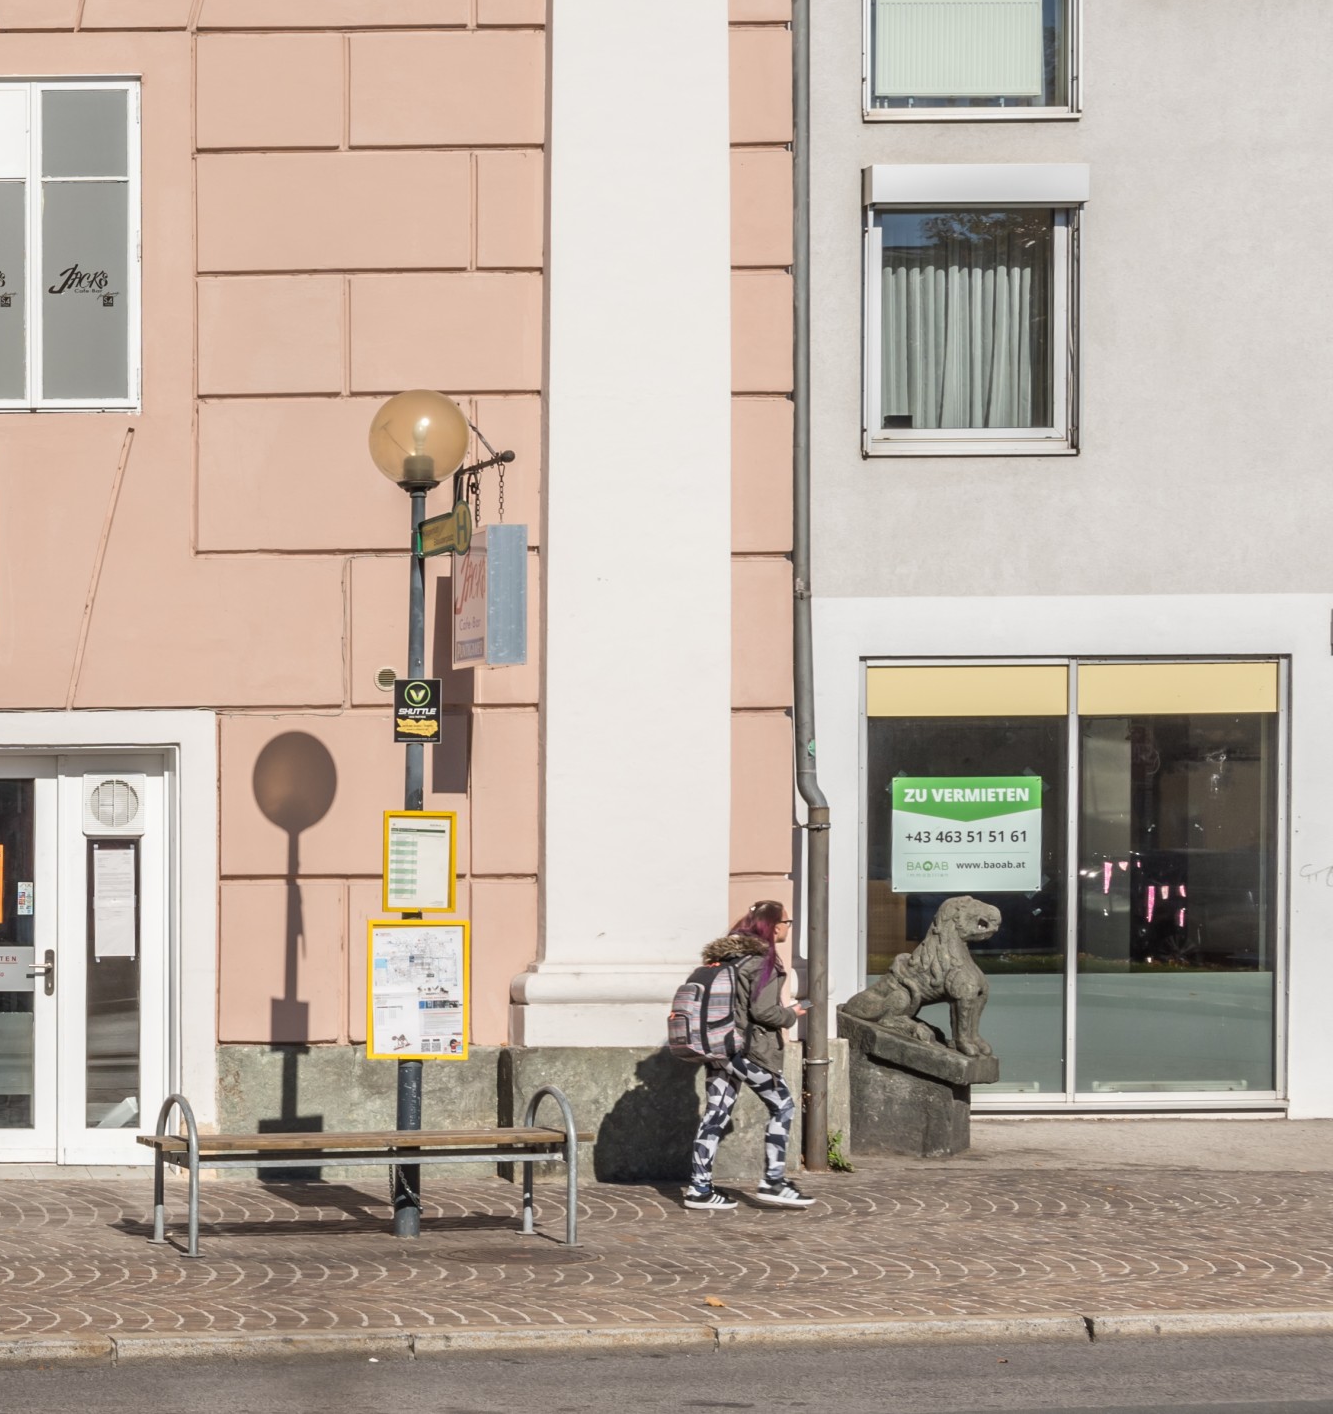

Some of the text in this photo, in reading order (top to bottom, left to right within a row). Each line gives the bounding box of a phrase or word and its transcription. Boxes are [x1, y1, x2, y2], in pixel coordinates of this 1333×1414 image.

[48, 263, 108, 294] JACKS
[398, 707, 437, 715] SHUTTLE
[904, 788, 1030, 803] ZU VERMIETEN
[905, 830, 1027, 843] +43 463 51 51 61
[956, 861, 1026, 869] www.baoab.at
